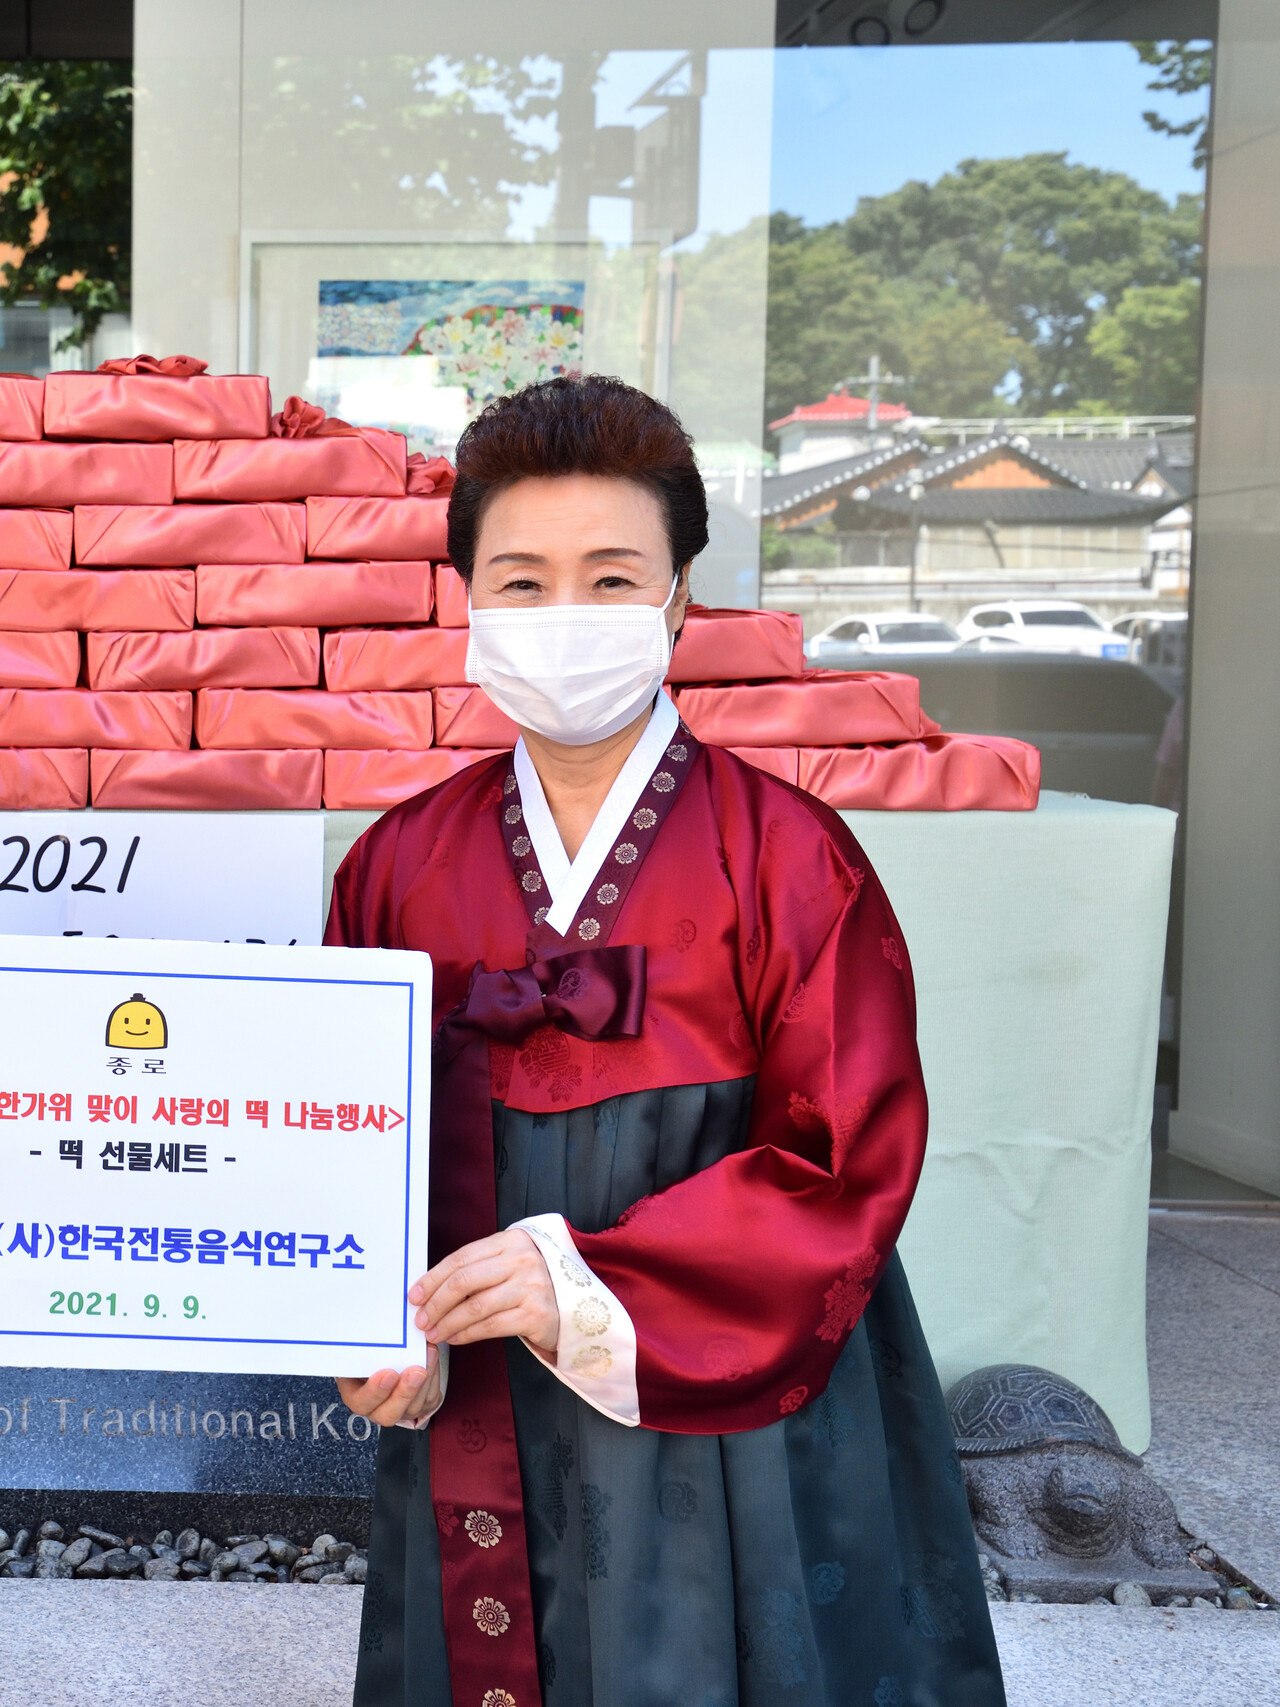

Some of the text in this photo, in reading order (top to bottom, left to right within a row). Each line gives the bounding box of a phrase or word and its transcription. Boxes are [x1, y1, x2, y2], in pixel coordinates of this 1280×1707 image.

[86, 1093, 138, 1125] 맞이
[151, 1096, 231, 1127] 사랑의
[244, 1099, 269, 1129] 떡
[283, 1101, 406, 1133] 나눔행사>
[58, 1138, 84, 1170] 떡
[98, 1140, 209, 1173] 선물세트
[48, 1290, 208, 1321] 2021. 9. 9.
[48, 1398, 297, 1442] Traditional
[310, 1402, 380, 1442] Ko
